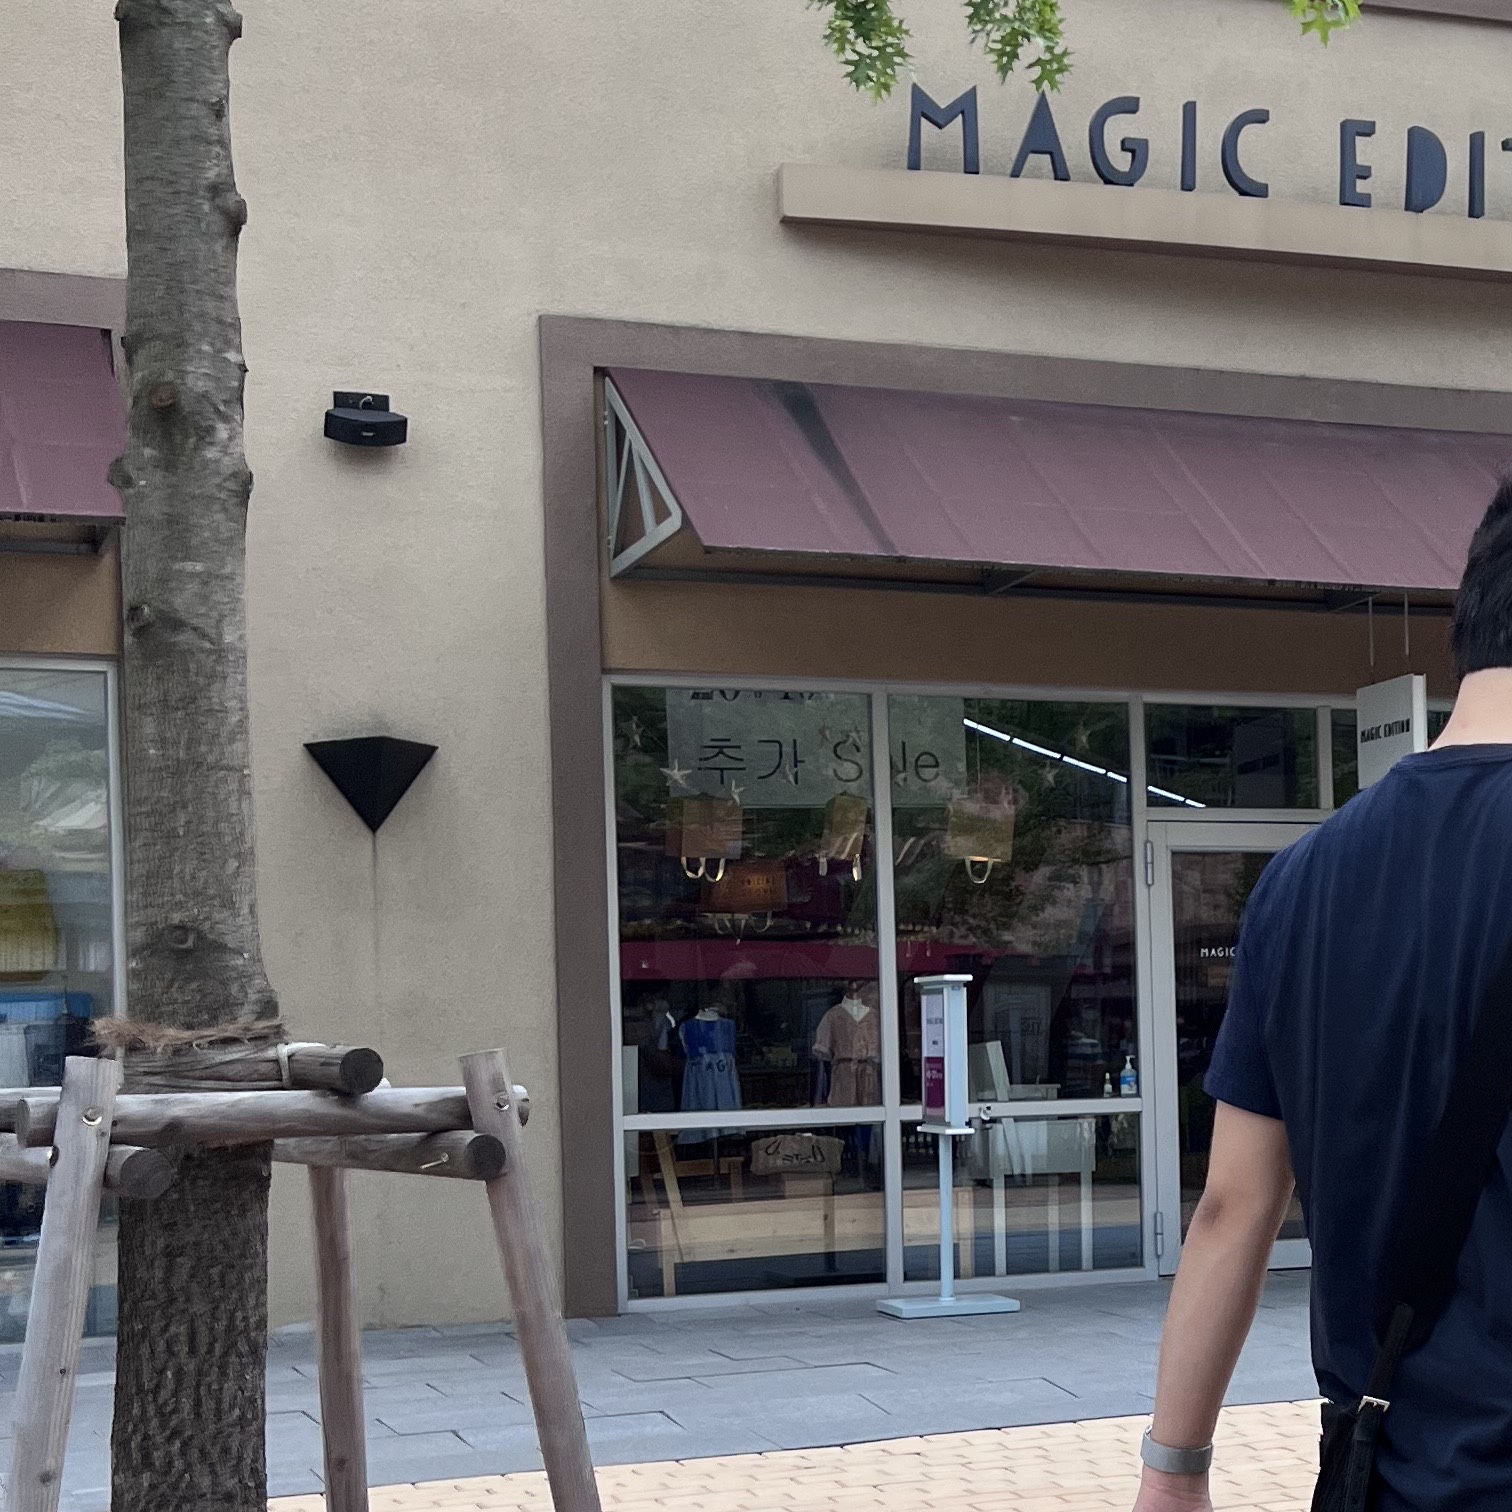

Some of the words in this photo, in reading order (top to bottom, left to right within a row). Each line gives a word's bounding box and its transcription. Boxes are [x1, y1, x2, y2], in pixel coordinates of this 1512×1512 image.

[907, 82, 1271, 198] MAGIC
[697, 737, 806, 785] 추가
[832, 738, 941, 785] Sle
[1200, 946, 1236, 958] MAGIC
